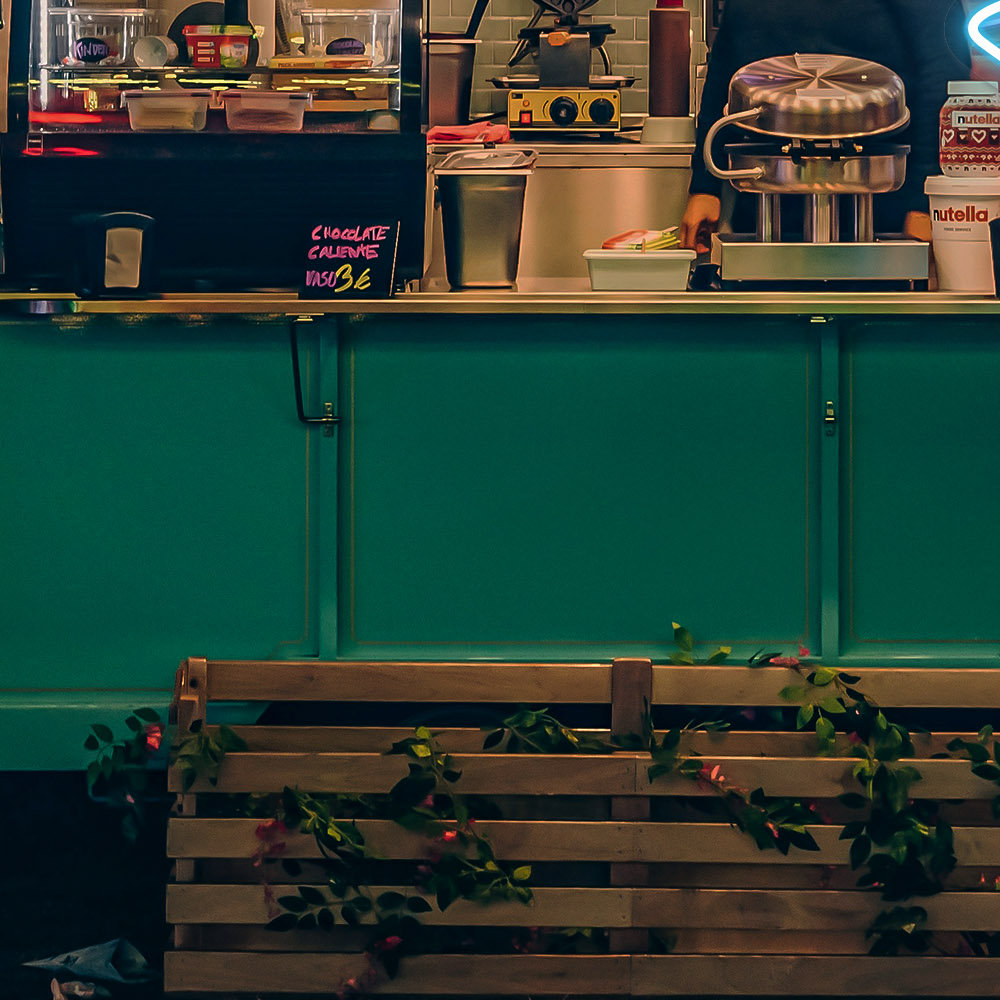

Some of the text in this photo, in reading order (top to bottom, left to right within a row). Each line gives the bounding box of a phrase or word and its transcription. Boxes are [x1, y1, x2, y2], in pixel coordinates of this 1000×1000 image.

[957, 112, 1000, 125] nutella
[933, 205, 989, 223] nutella
[311, 224, 390, 242] CHOCOLATE
